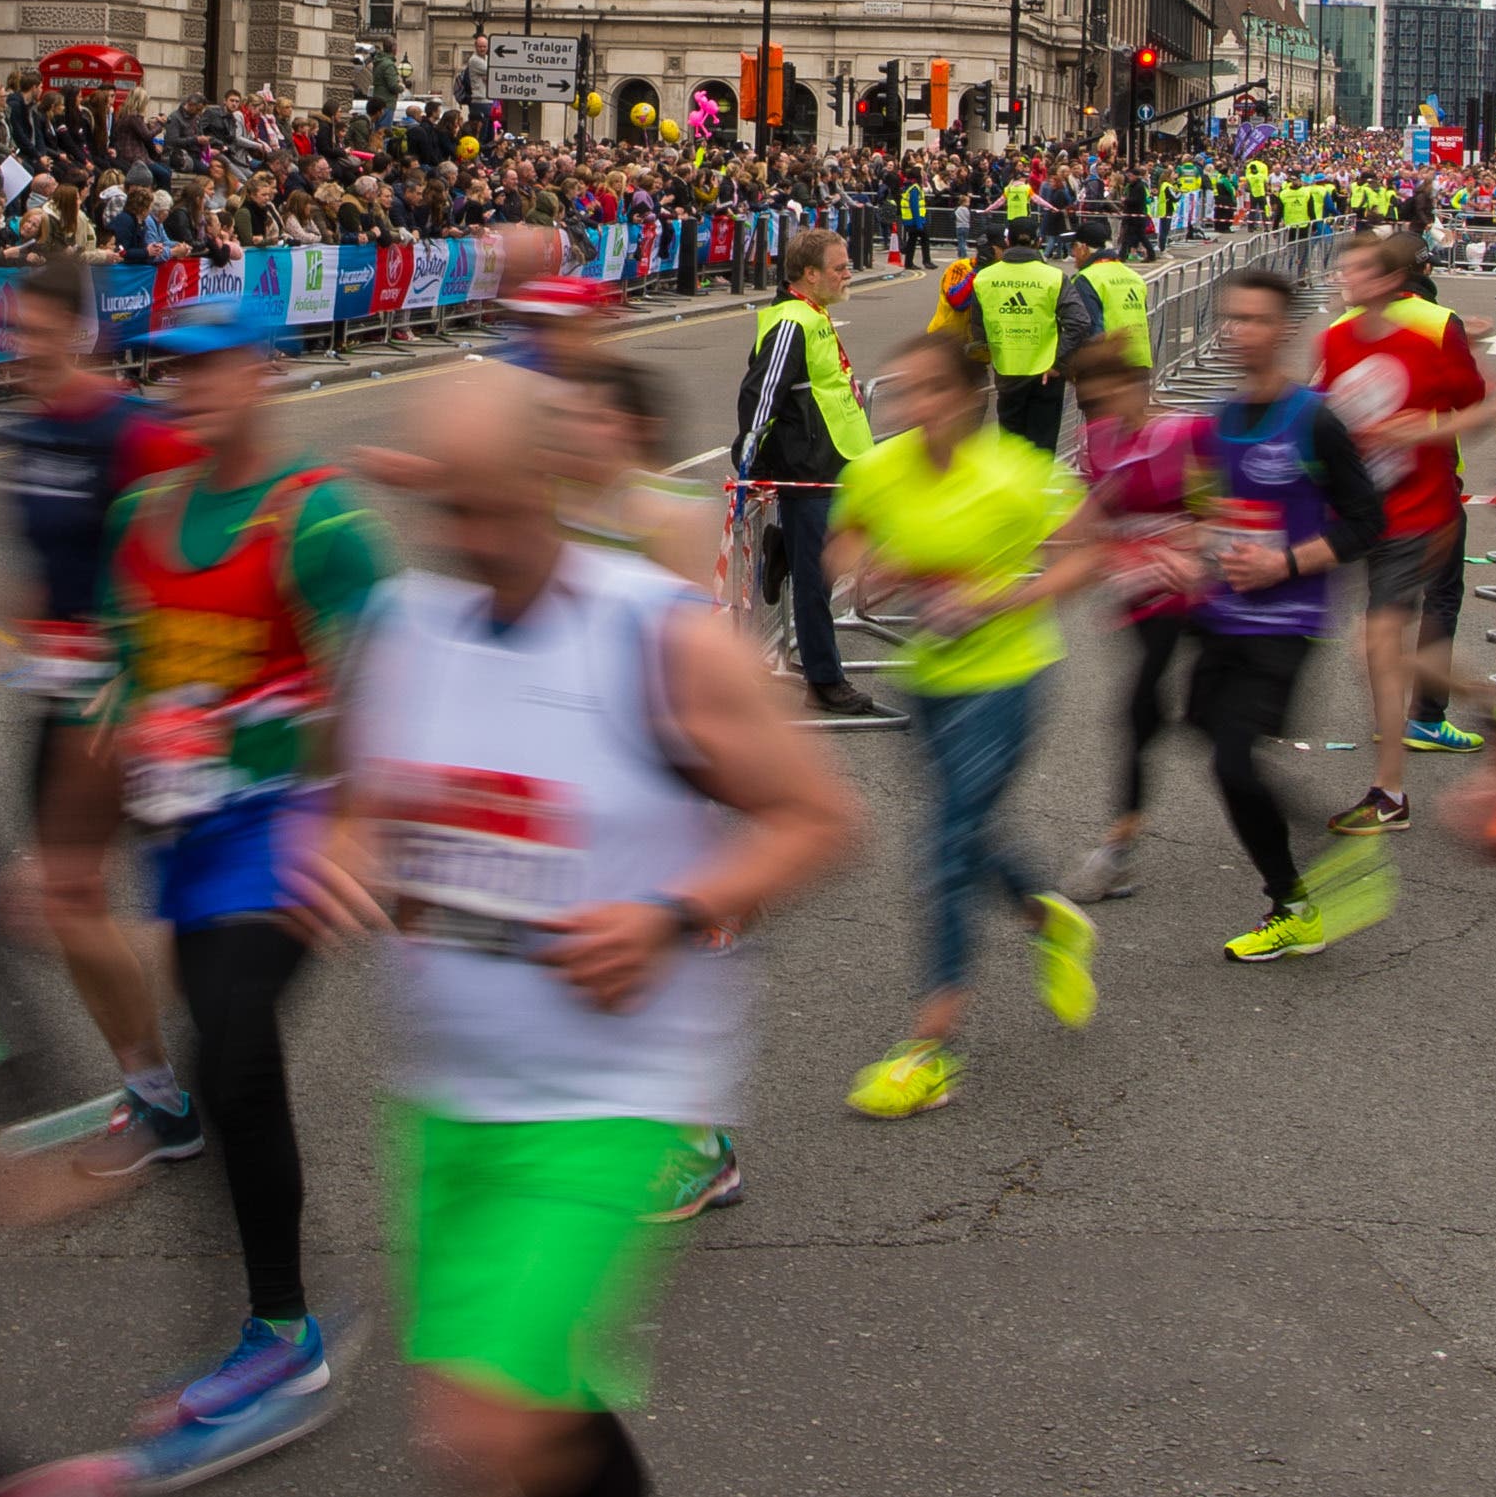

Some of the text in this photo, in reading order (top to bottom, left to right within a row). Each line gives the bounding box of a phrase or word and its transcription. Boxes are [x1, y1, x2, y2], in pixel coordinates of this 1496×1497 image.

[522, 41, 573, 54] Trafalgar
[527, 54, 567, 65] Square
[495, 72, 543, 83] Lambeth
[501, 84, 537, 96] Bridge
[414, 255, 446, 281] Buxton
[991, 280, 1044, 289] MARSHAL
[380, 288, 401, 302] money
[101, 292, 144, 313] Lucozade
[998, 305, 1033, 315] adidas
